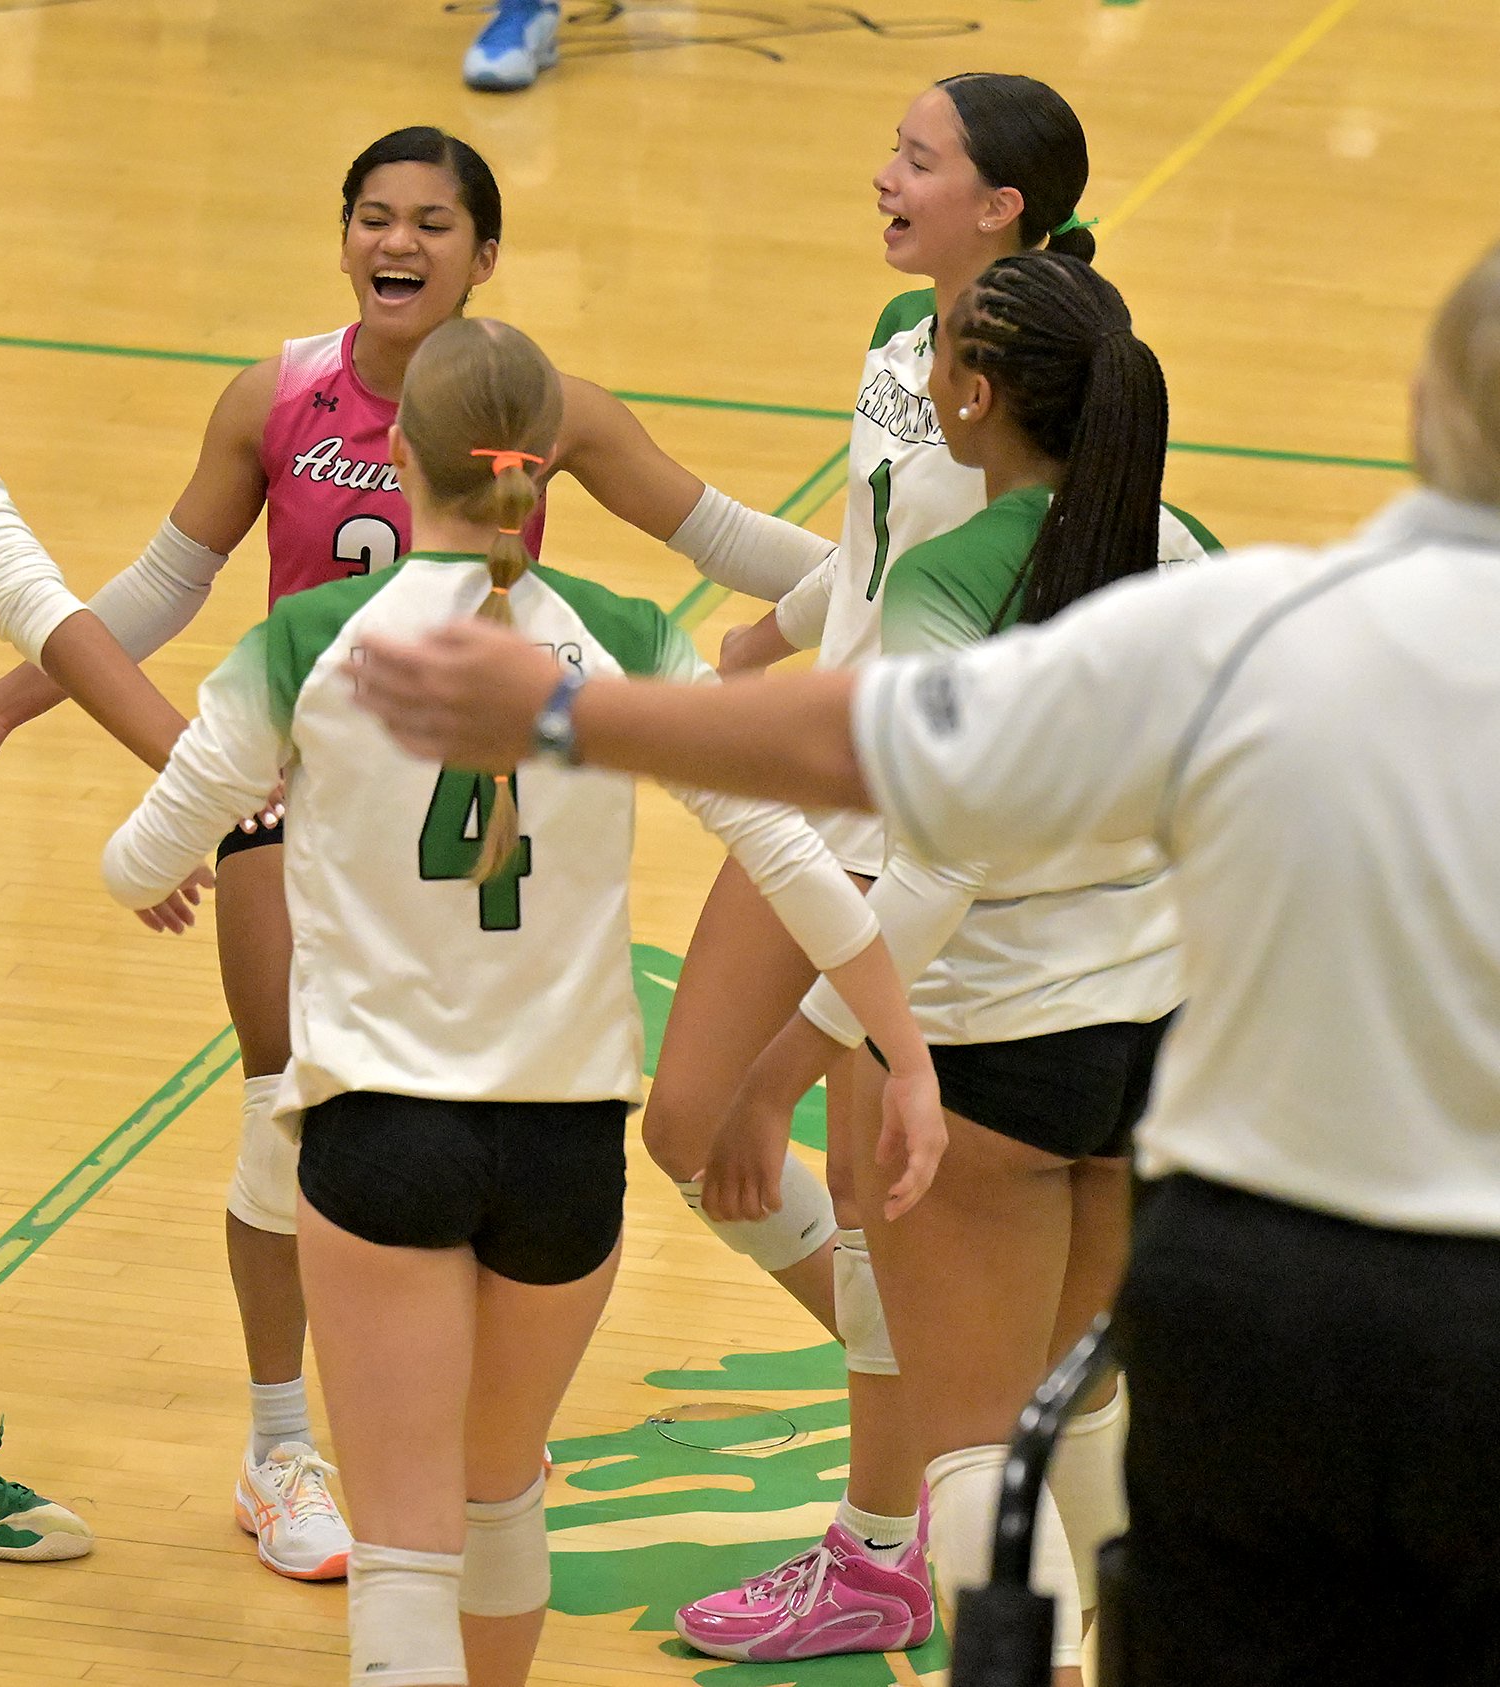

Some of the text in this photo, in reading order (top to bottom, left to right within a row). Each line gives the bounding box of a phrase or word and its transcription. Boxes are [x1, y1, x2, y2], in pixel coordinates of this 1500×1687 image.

[856, 368, 947, 446] ARUND
[291, 436, 403, 492] Arun
[865, 457, 893, 603] 1
[418, 764, 532, 931] 4
